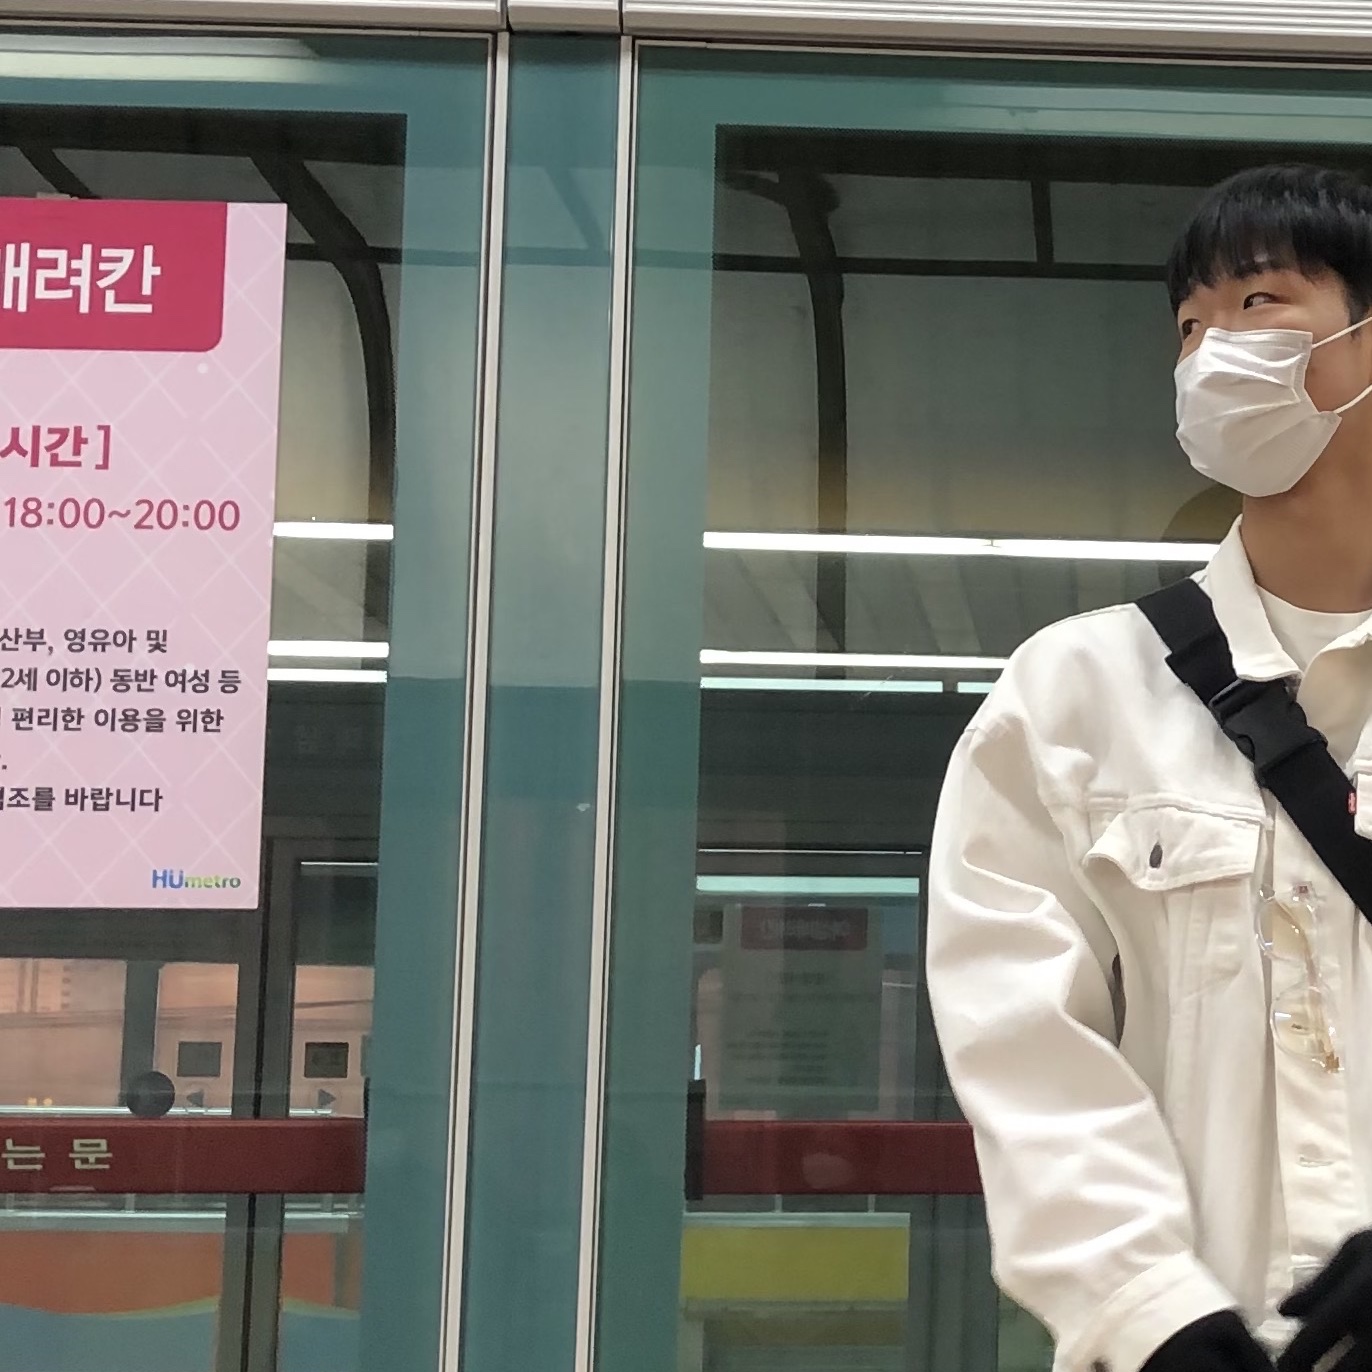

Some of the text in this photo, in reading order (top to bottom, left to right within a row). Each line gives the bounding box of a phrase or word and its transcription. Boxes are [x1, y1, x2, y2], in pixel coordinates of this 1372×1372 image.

[0, 424, 111, 470] 시간]
[4, 496, 241, 531] 18:00~20:00
[0, 627, 168, 656] 산부, 영유아 및
[1, 667, 242, 694] 2세 이하) 동반 여성 등
[12, 707, 224, 733] 편리한 이용을 위한
[0, 786, 164, 812] 조를 바랍니다
[151, 869, 242, 890] HUmetro
[1, 1138, 113, 1170] 는 문
